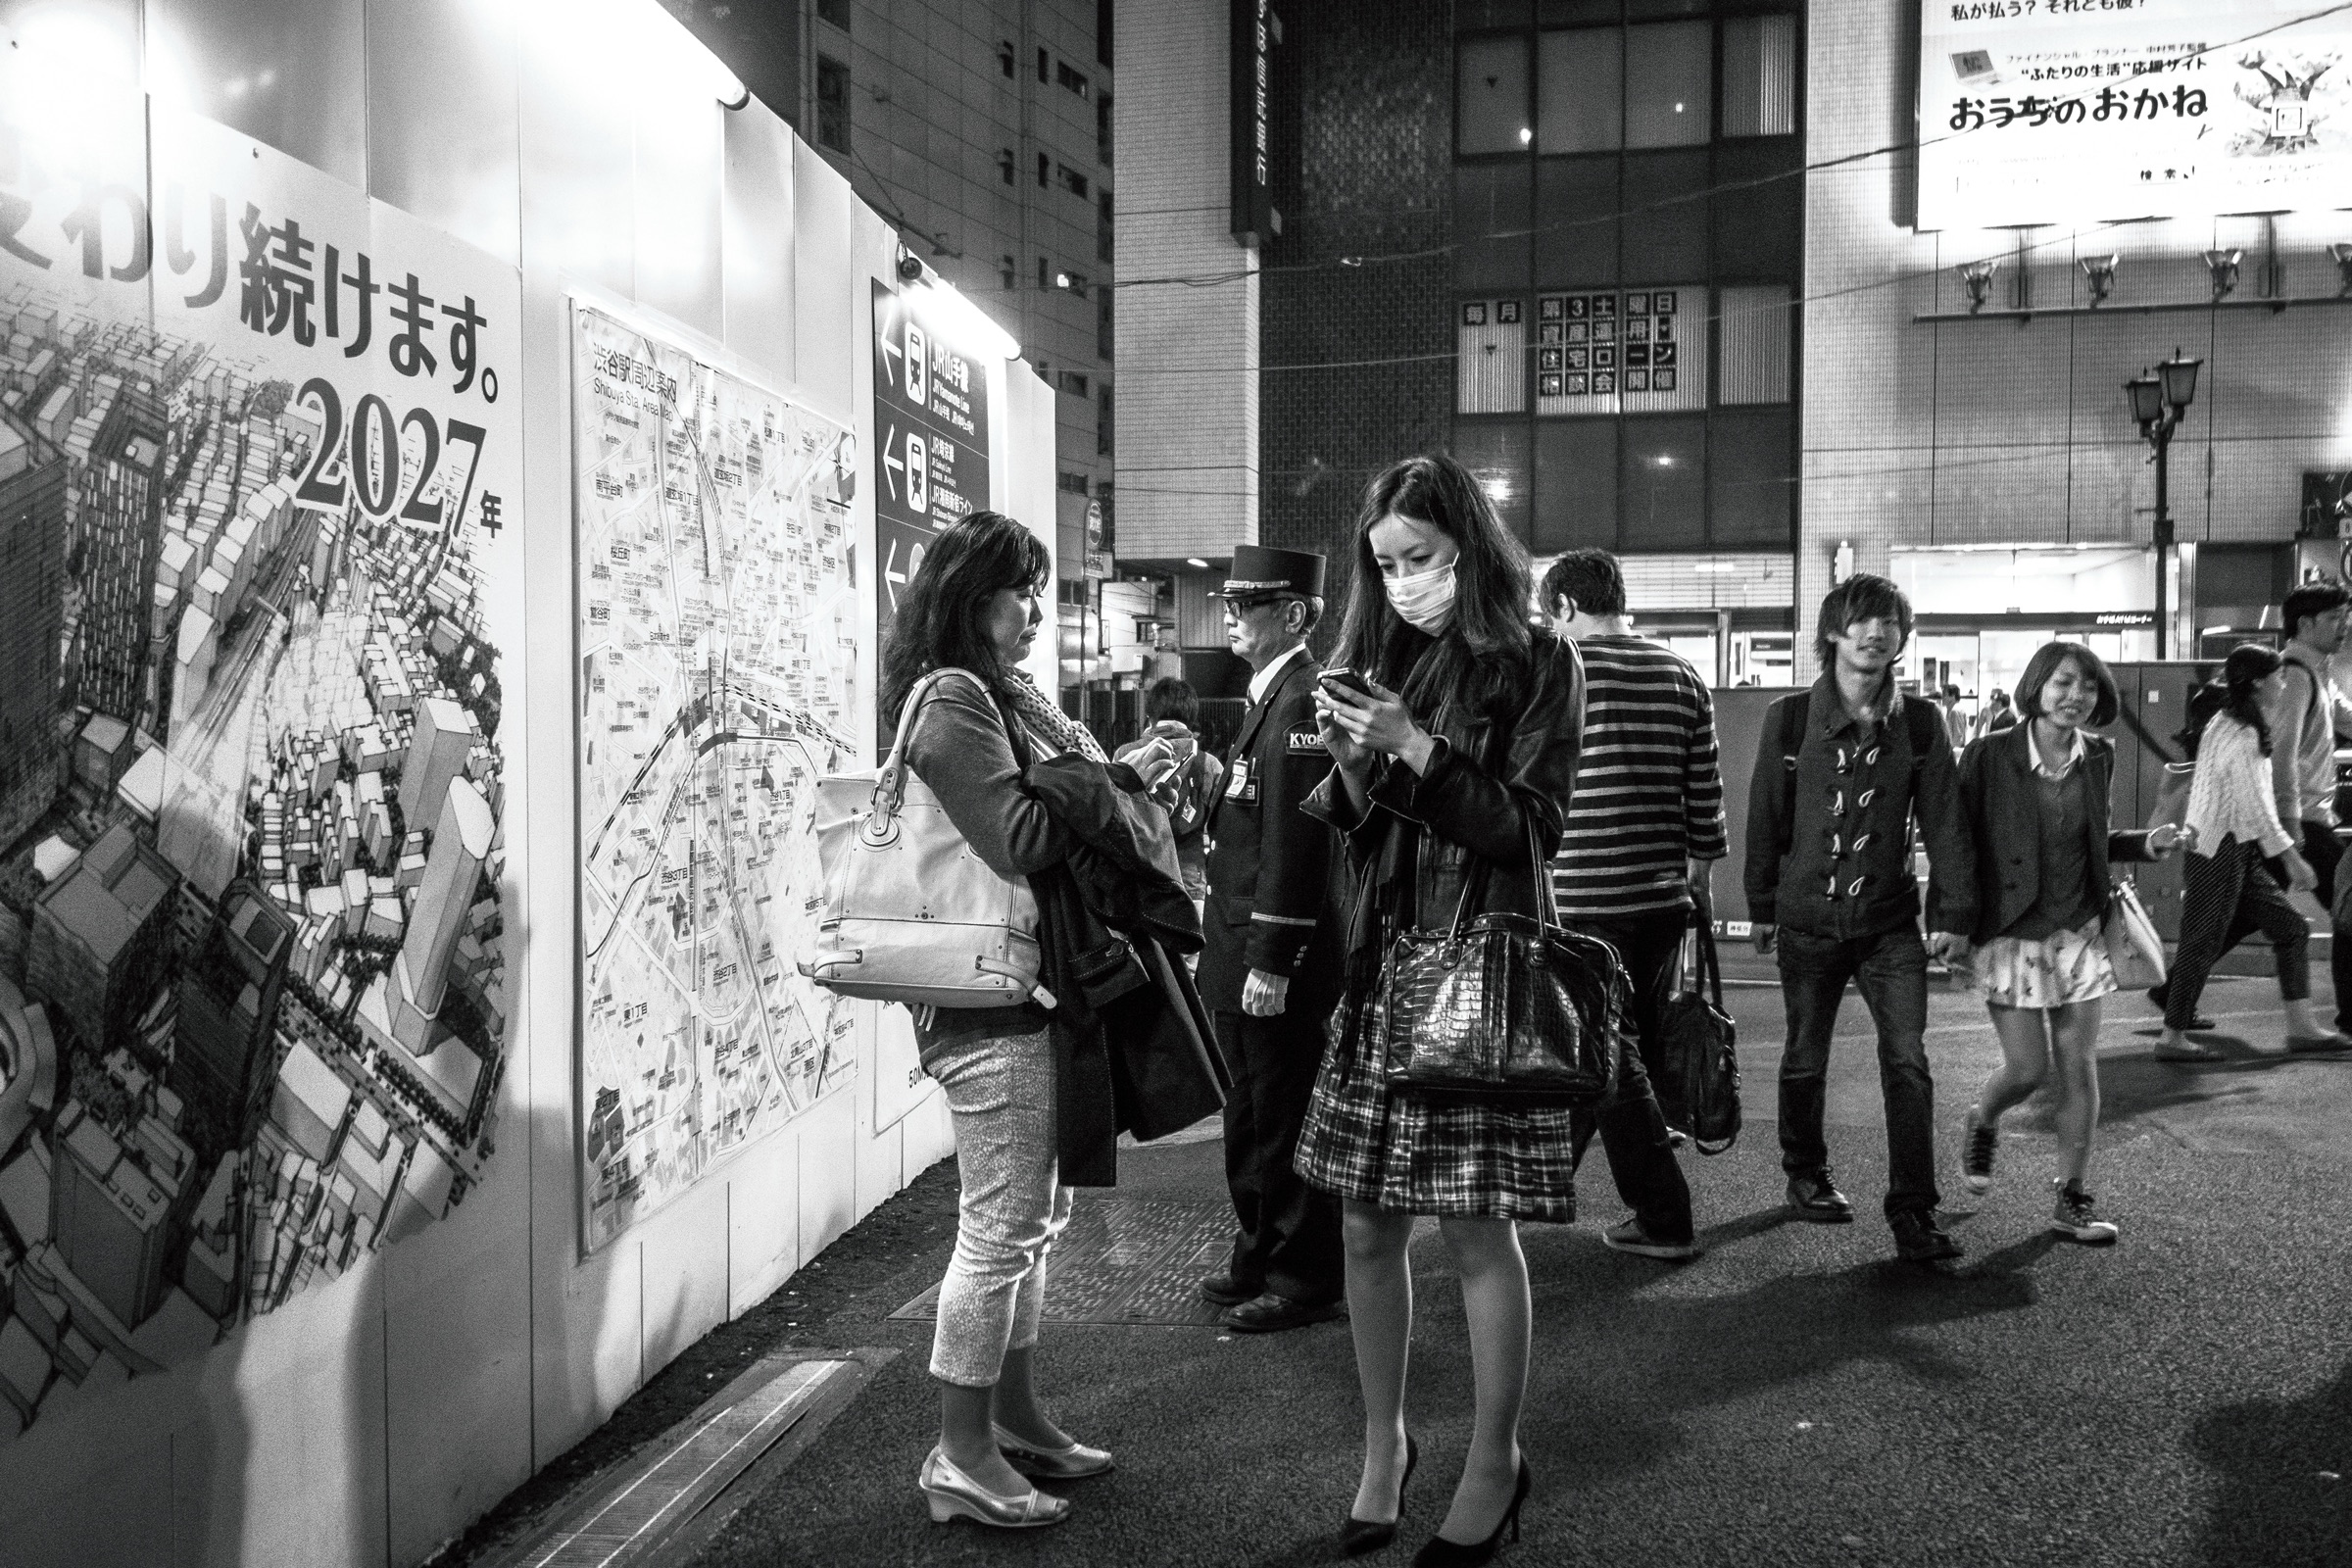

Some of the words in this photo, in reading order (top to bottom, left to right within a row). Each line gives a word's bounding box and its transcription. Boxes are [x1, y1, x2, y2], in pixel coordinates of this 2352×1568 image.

[1949, 84, 2208, 130] おうちのおかね
[1466, 304, 1517, 324] 毎月
[1542, 293, 1673, 318] 第3土曜日
[593, 341, 677, 403] 渋谷駅周辺案内
[1542, 346, 1672, 370] 住宅ローン
[593, 376, 624, 405] Shibuya
[642, 396, 659, 416] Area
[660, 402, 673, 425] Map
[296, 377, 503, 539] 2027年
[623, 1001, 648, 1021] 東1丁目
